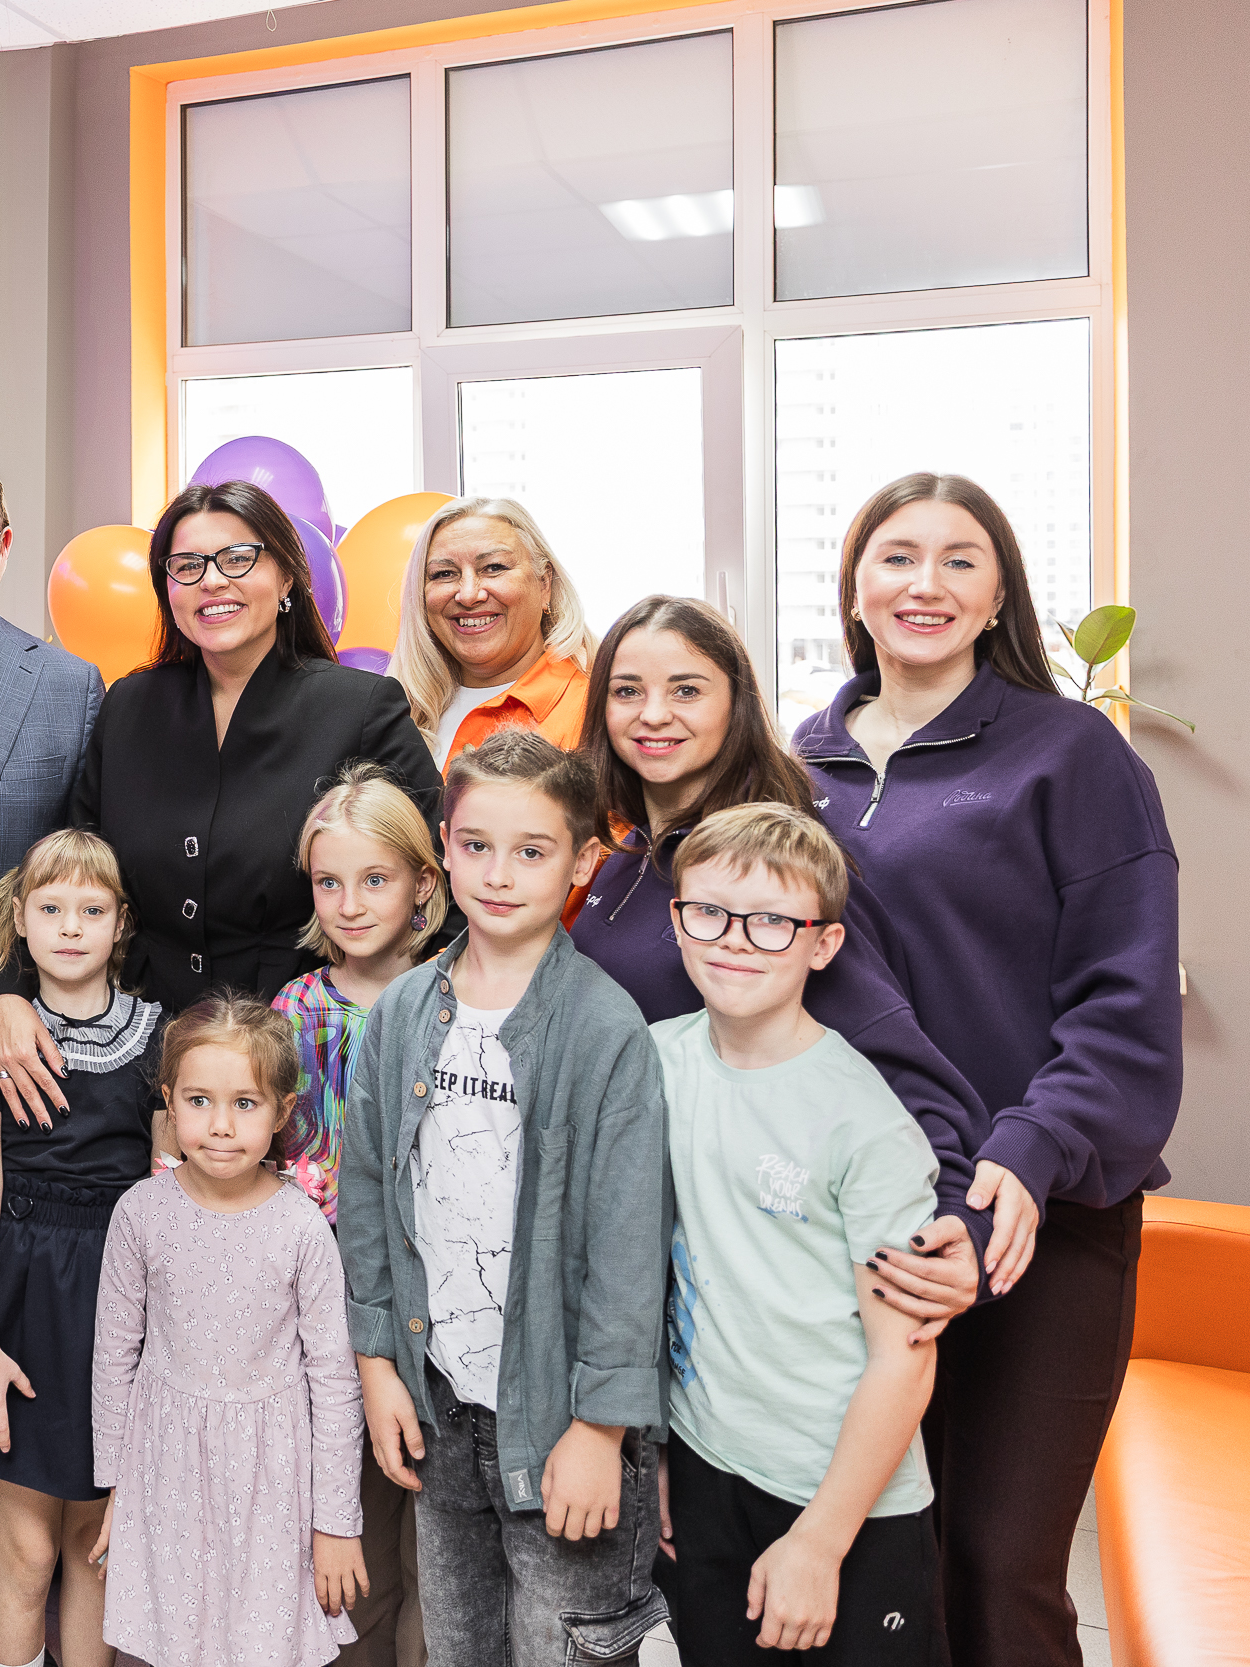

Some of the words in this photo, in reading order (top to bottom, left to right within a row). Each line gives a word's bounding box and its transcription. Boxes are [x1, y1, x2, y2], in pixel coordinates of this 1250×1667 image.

[433, 1068, 458, 1092] EEP
[462, 1075, 479, 1097] IT
[755, 1154, 810, 1185] REACH
[769, 1177, 806, 1200] YOUR
[759, 1191, 803, 1219] DREAMS
